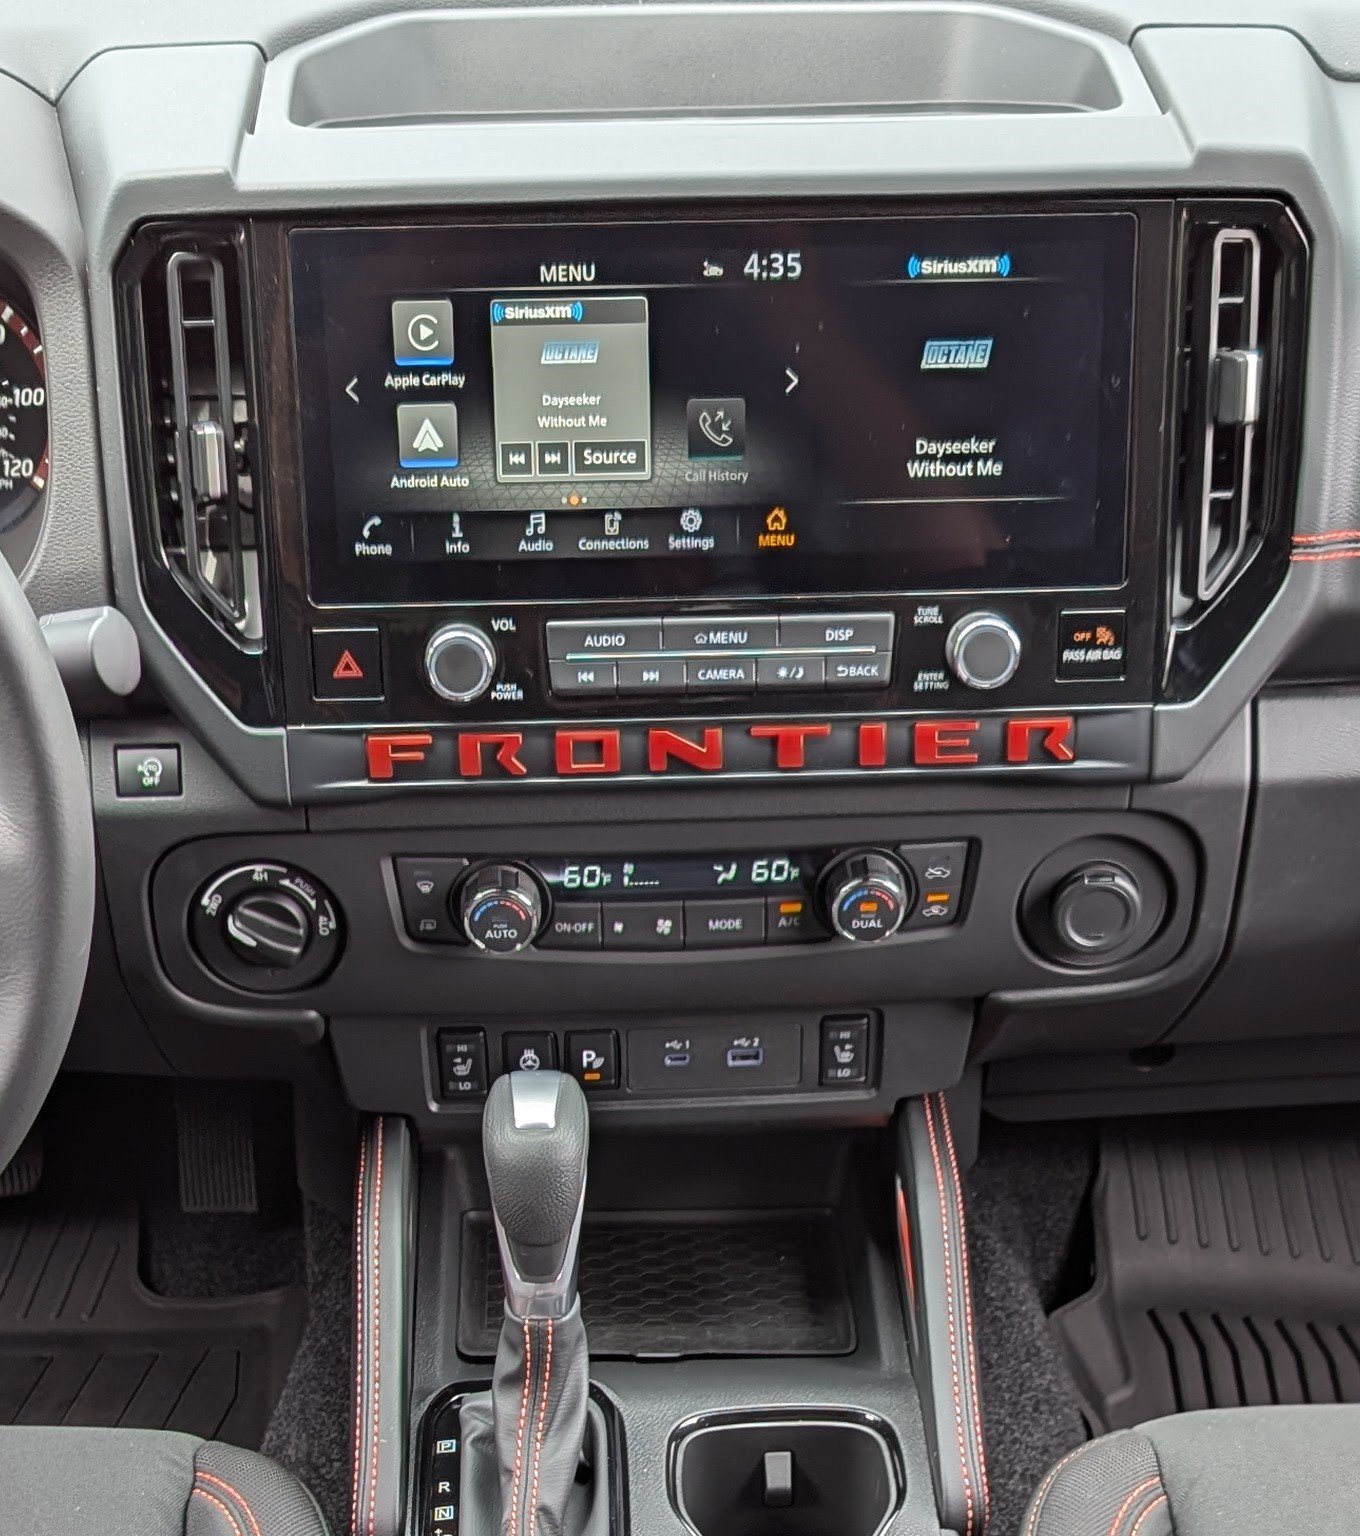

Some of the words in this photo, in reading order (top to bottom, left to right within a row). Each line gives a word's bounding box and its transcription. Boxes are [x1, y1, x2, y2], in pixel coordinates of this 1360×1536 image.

[540, 264, 595, 282] MENU
[743, 252, 802, 281] 4:35
[384, 373, 420, 390] Apple
[422, 373, 466, 388] CarPlay
[13, 388, 45, 407] 100
[542, 394, 601, 409] Dayseeker
[537, 416, 586, 428] Without
[589, 416, 607, 428] Me
[916, 435, 996, 458] Dayseeker
[583, 450, 637, 466] Source
[3, 459, 34, 477] 120
[907, 459, 974, 478] Without
[977, 459, 1003, 477] Me
[390, 475, 438, 489] Android
[440, 475, 470, 488] Auto
[685, 470, 707, 482] Call
[708, 469, 749, 484] History
[445, 540, 470, 554] Info
[518, 538, 554, 552] Audio
[578, 537, 649, 551] Connections
[668, 535, 715, 551] Settings
[758, 534, 795, 548] MENU
[354, 541, 392, 556] Phone
[917, 606, 939, 616] TUNE
[491, 618, 516, 631] VOL
[914, 615, 943, 624] SCROLL
[584, 634, 626, 648] AUDIO
[709, 632, 748, 645] MENU
[825, 629, 854, 642] DISP
[1073, 632, 1091, 643] OFF
[1062, 650, 1085, 662] PASS
[1102, 649, 1122, 661] BAG
[697, 668, 745, 681] CAMERA
[849, 665, 879, 678] BACK
[917, 672, 944, 681] ENTER
[491, 691, 523, 700] POWER
[366, 716, 1076, 778] FRONTIER
[252, 872, 269, 882] 4H
[294, 877, 316, 897] PUSH
[708, 918, 743, 930] MODE
[851, 919, 883, 929] DUAL
[485, 929, 518, 939] AUTO
[582, 1050, 596, 1068] P
[438, 1482, 451, 1493] R
